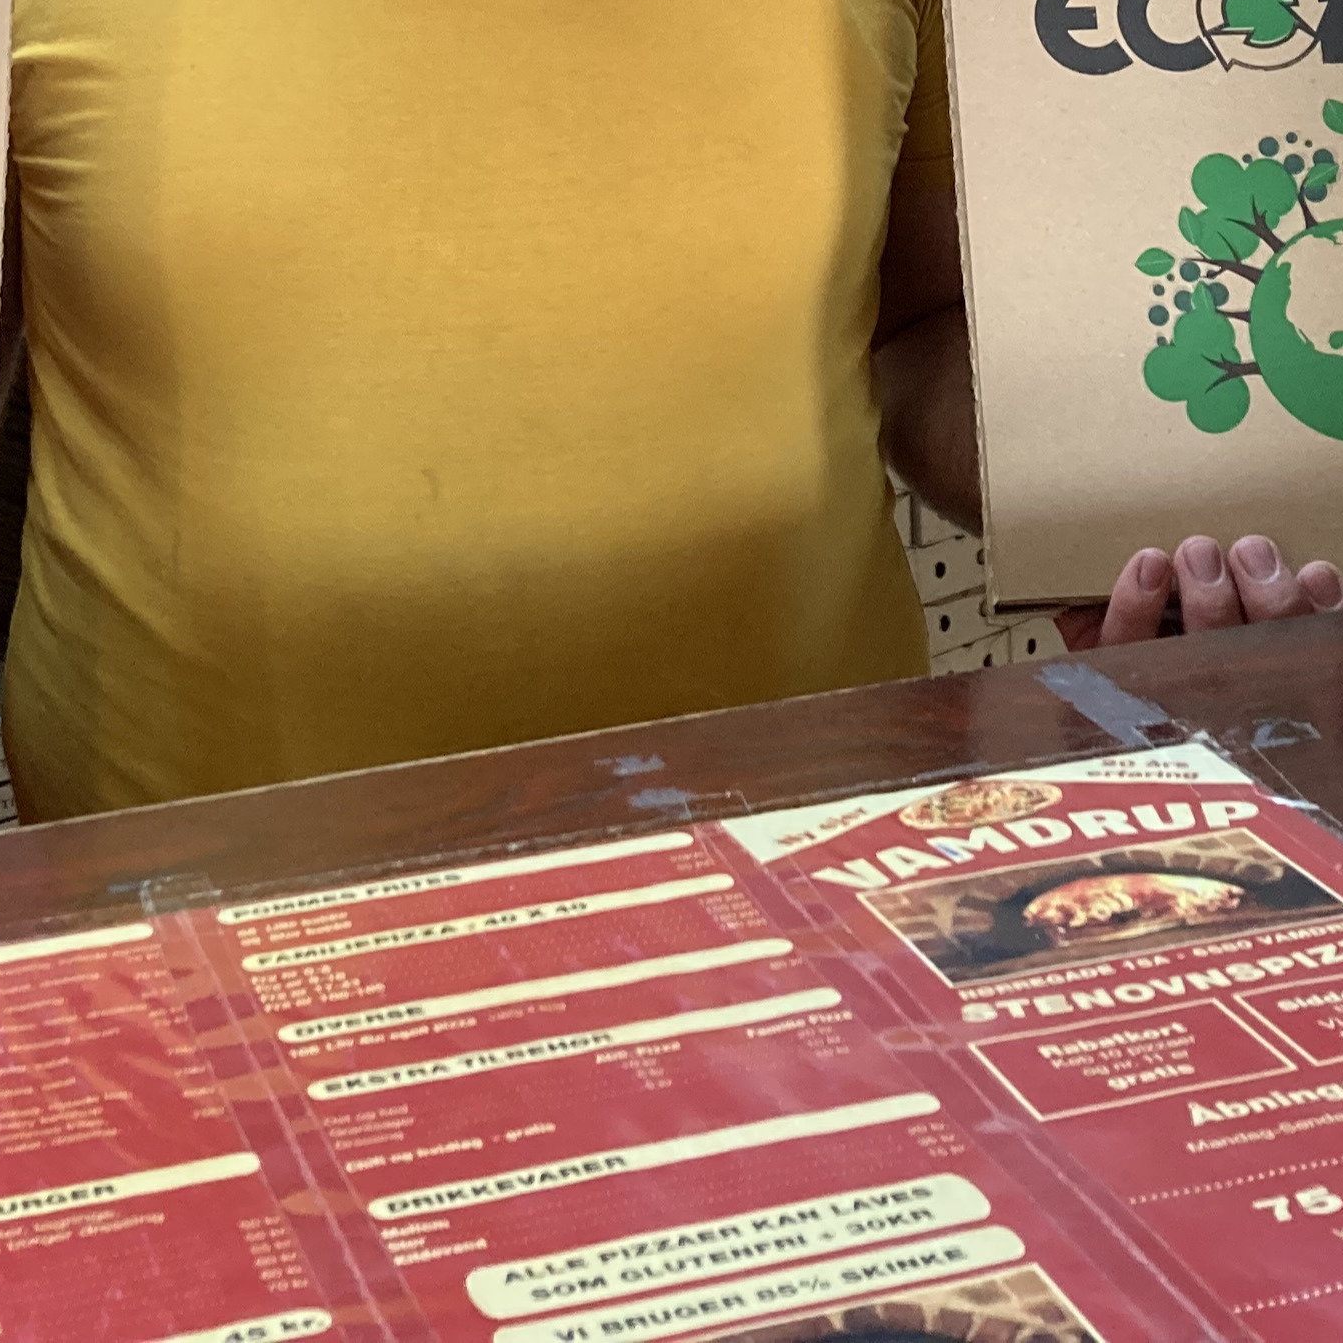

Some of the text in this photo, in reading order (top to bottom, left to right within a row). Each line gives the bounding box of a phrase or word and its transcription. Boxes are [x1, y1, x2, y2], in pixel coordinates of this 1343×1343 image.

[1086, 766, 1201, 781] erfaring
[811, 799, 1260, 891] VAMDRUP
[232, 872, 463, 920] POMMES FRITES
[257, 925, 458, 967] FAMILIEPIZZA
[294, 1005, 425, 1039] DIVERSE
[1037, 1021, 1188, 1059] Rabatkort
[324, 1062, 453, 1095] EKSTRA
[1107, 1063, 1196, 1091] gratis
[504, 1121, 558, 1143] gratis
[386, 1154, 628, 1215] DRIKKEVARER
[1252, 1185, 1343, 1223] 75
[502, 1183, 936, 1288] ALLE PIZZAER KAN LAVES
[528, 1273, 609, 1303] SOM
[618, 1233, 810, 1287] GLUTENFRI
[553, 1320, 594, 1343] VI
[598, 1294, 749, 1336] BRUGER
[838, 1246, 970, 1286] SKINKE
